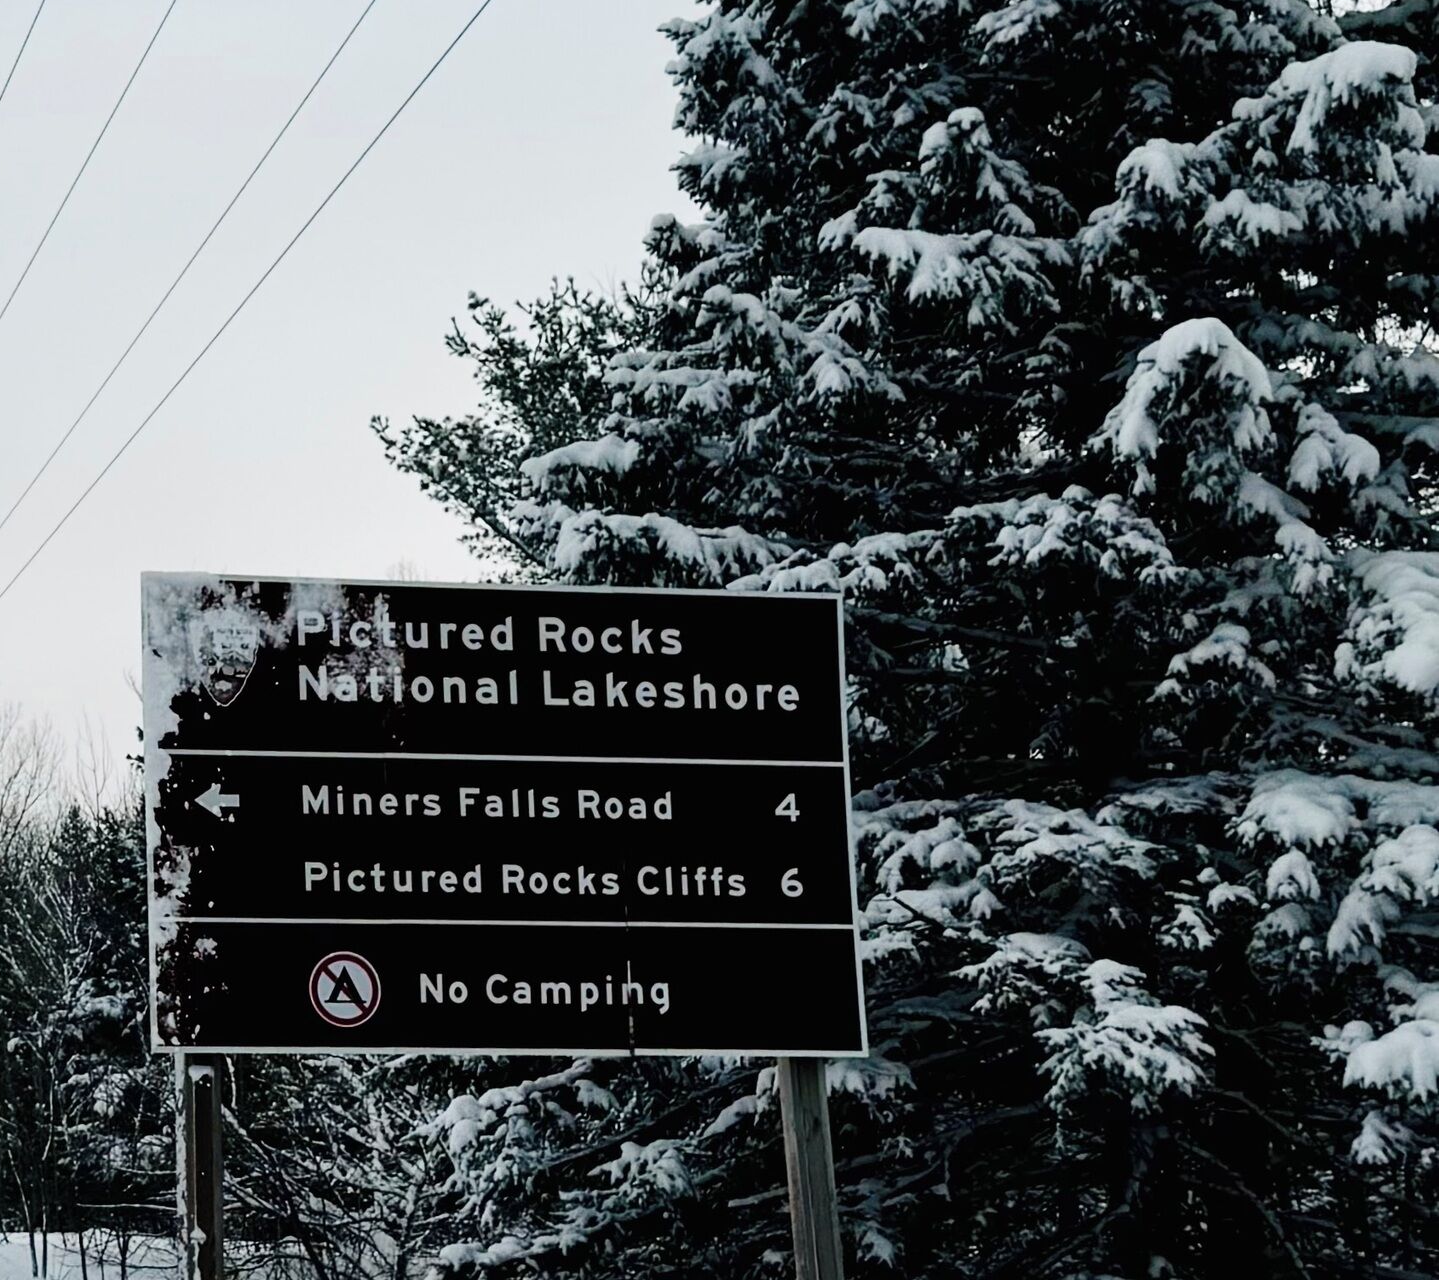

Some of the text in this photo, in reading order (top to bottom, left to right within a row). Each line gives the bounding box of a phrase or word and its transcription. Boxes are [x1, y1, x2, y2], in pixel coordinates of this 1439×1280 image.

[297, 609, 514, 651] Pictured
[538, 616, 683, 655] Rocks
[298, 664, 800, 712] National Lakeshore
[302, 784, 801, 823] Miners Falls Road 4
[304, 861, 804, 898] Pictured Rocks Cliffs 6
[419, 973, 670, 1014] No Camping
